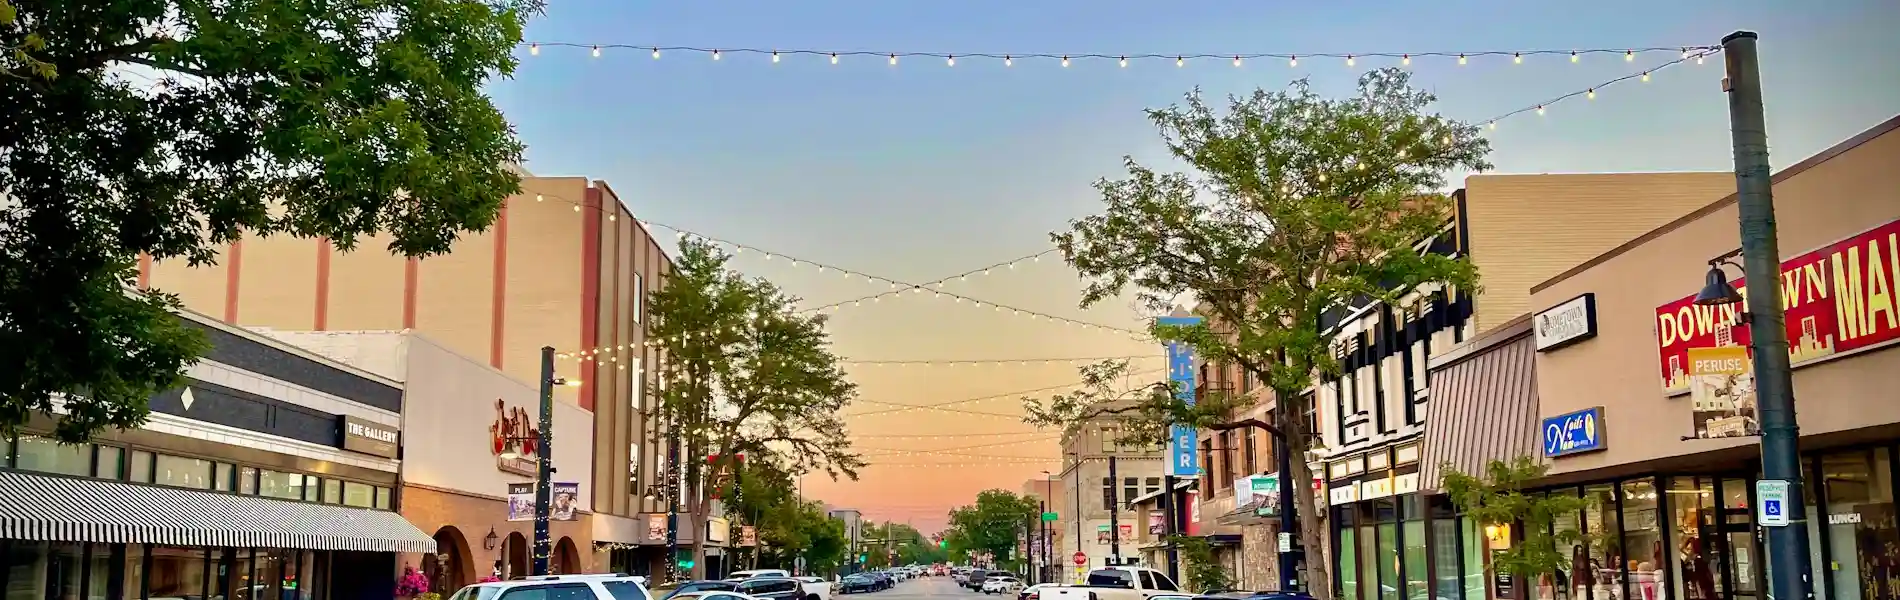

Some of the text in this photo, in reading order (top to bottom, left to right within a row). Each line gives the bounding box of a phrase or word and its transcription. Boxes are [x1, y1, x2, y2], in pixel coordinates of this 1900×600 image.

[1695, 358, 1743, 373] PERUSE
[348, 422, 396, 443] THE GALLERY
[1828, 513, 1861, 524] LUNCH
